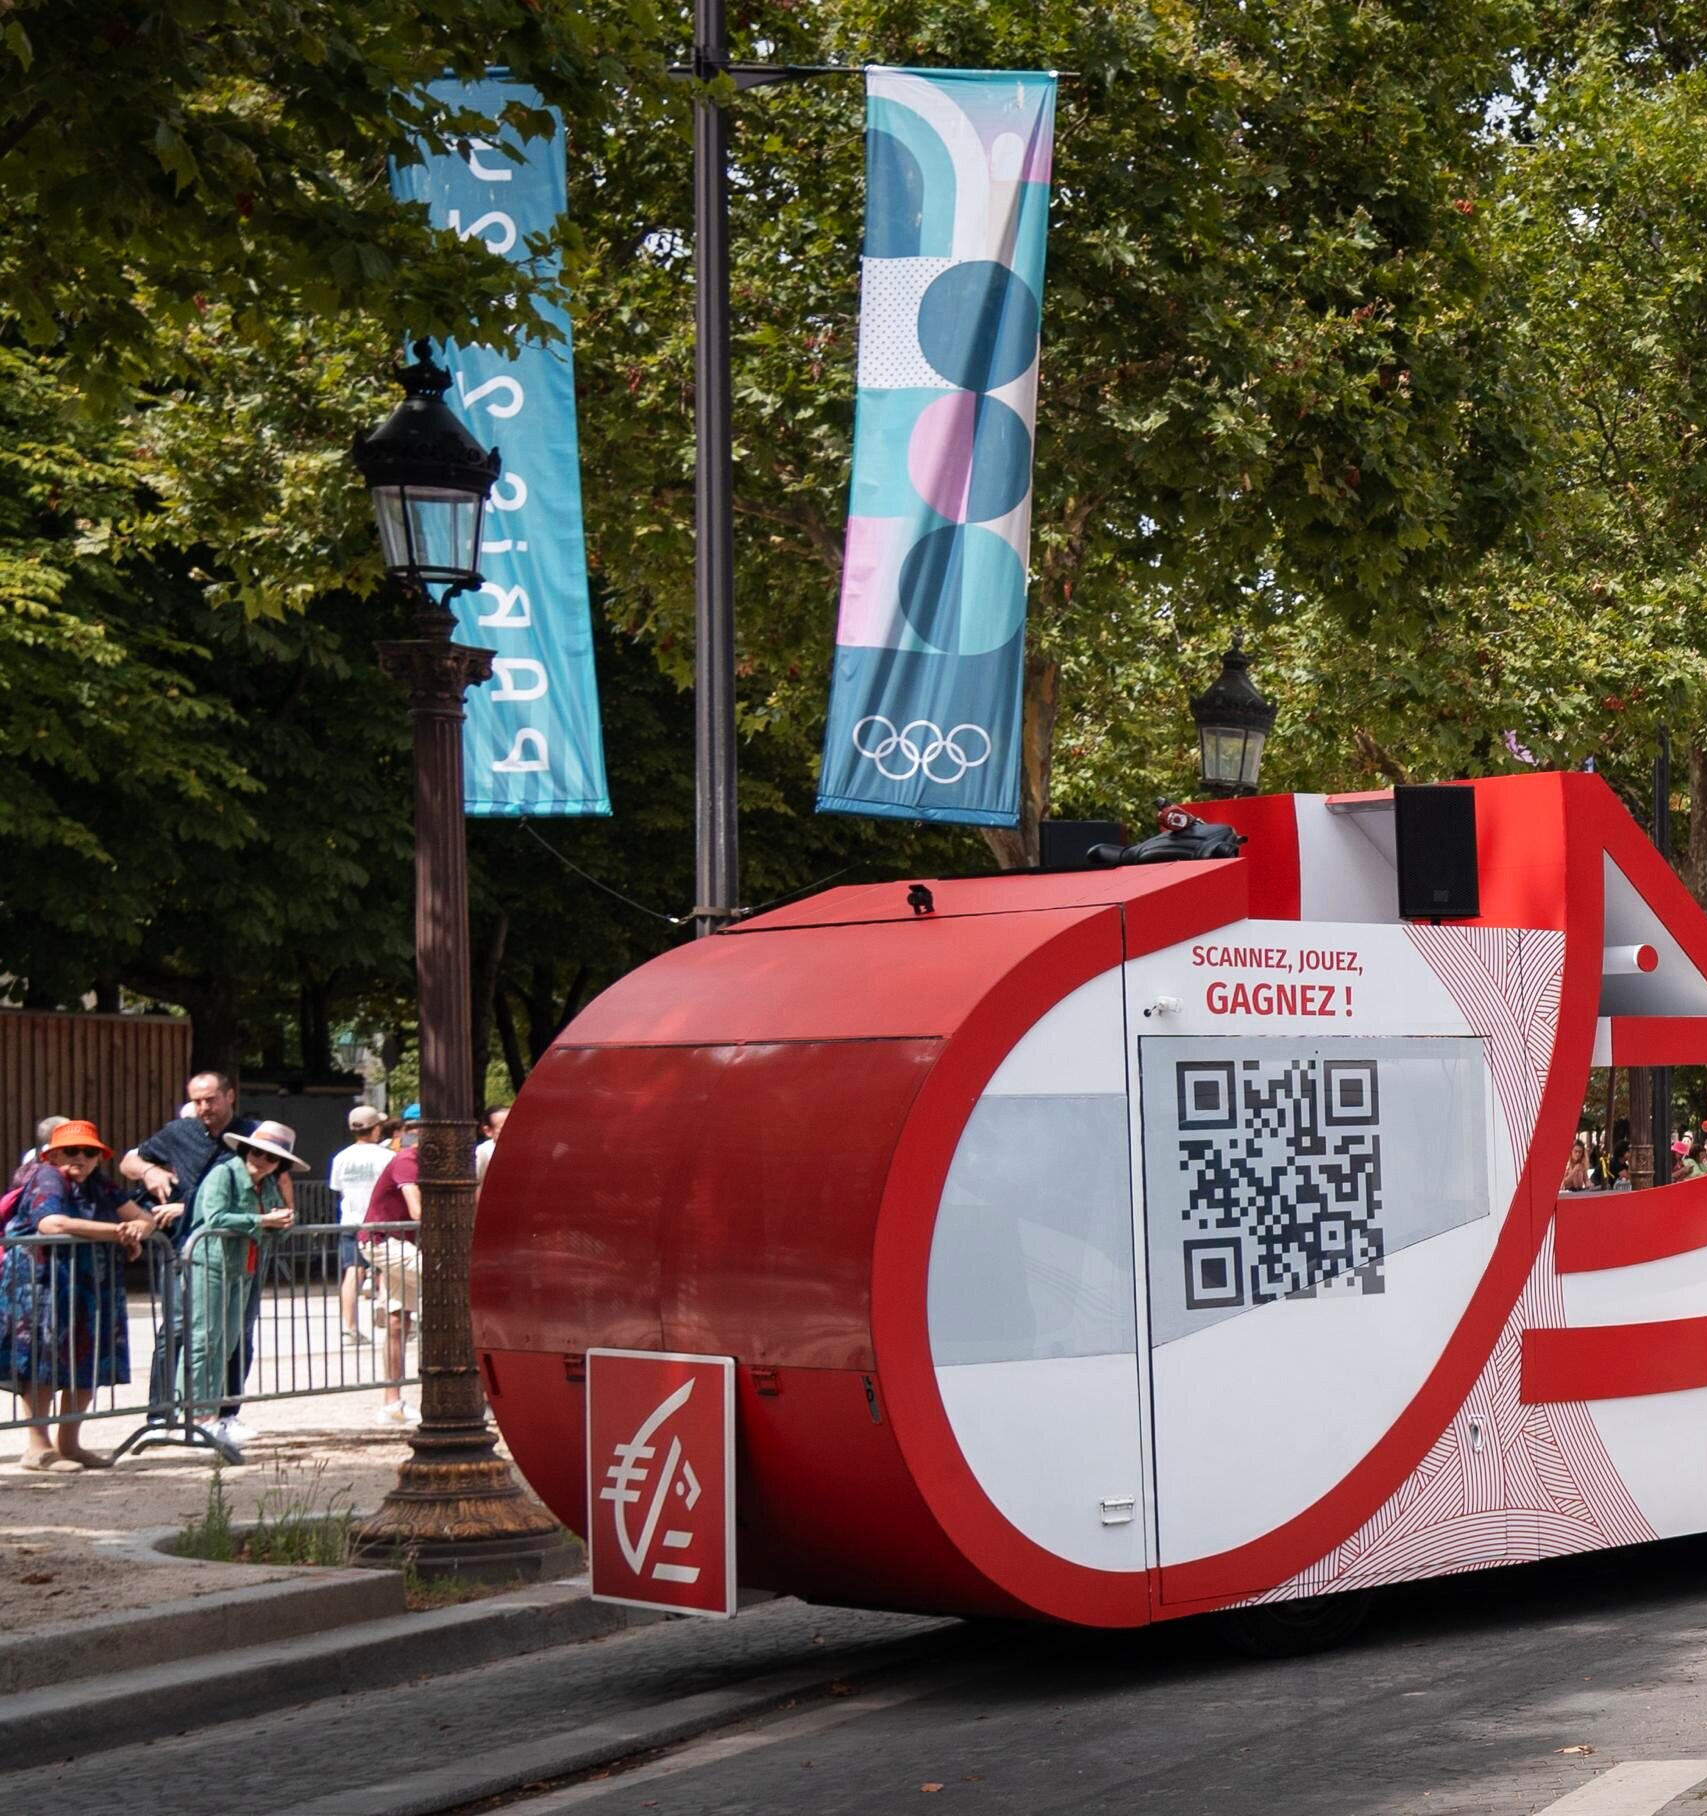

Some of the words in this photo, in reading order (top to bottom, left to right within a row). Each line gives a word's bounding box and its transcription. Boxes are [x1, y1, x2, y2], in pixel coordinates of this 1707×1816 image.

[1192, 945, 1293, 974] SCANNEZ,
[1298, 949, 1364, 976] JOUEZ,
[1205, 981, 1336, 1017] GAGNEZ
